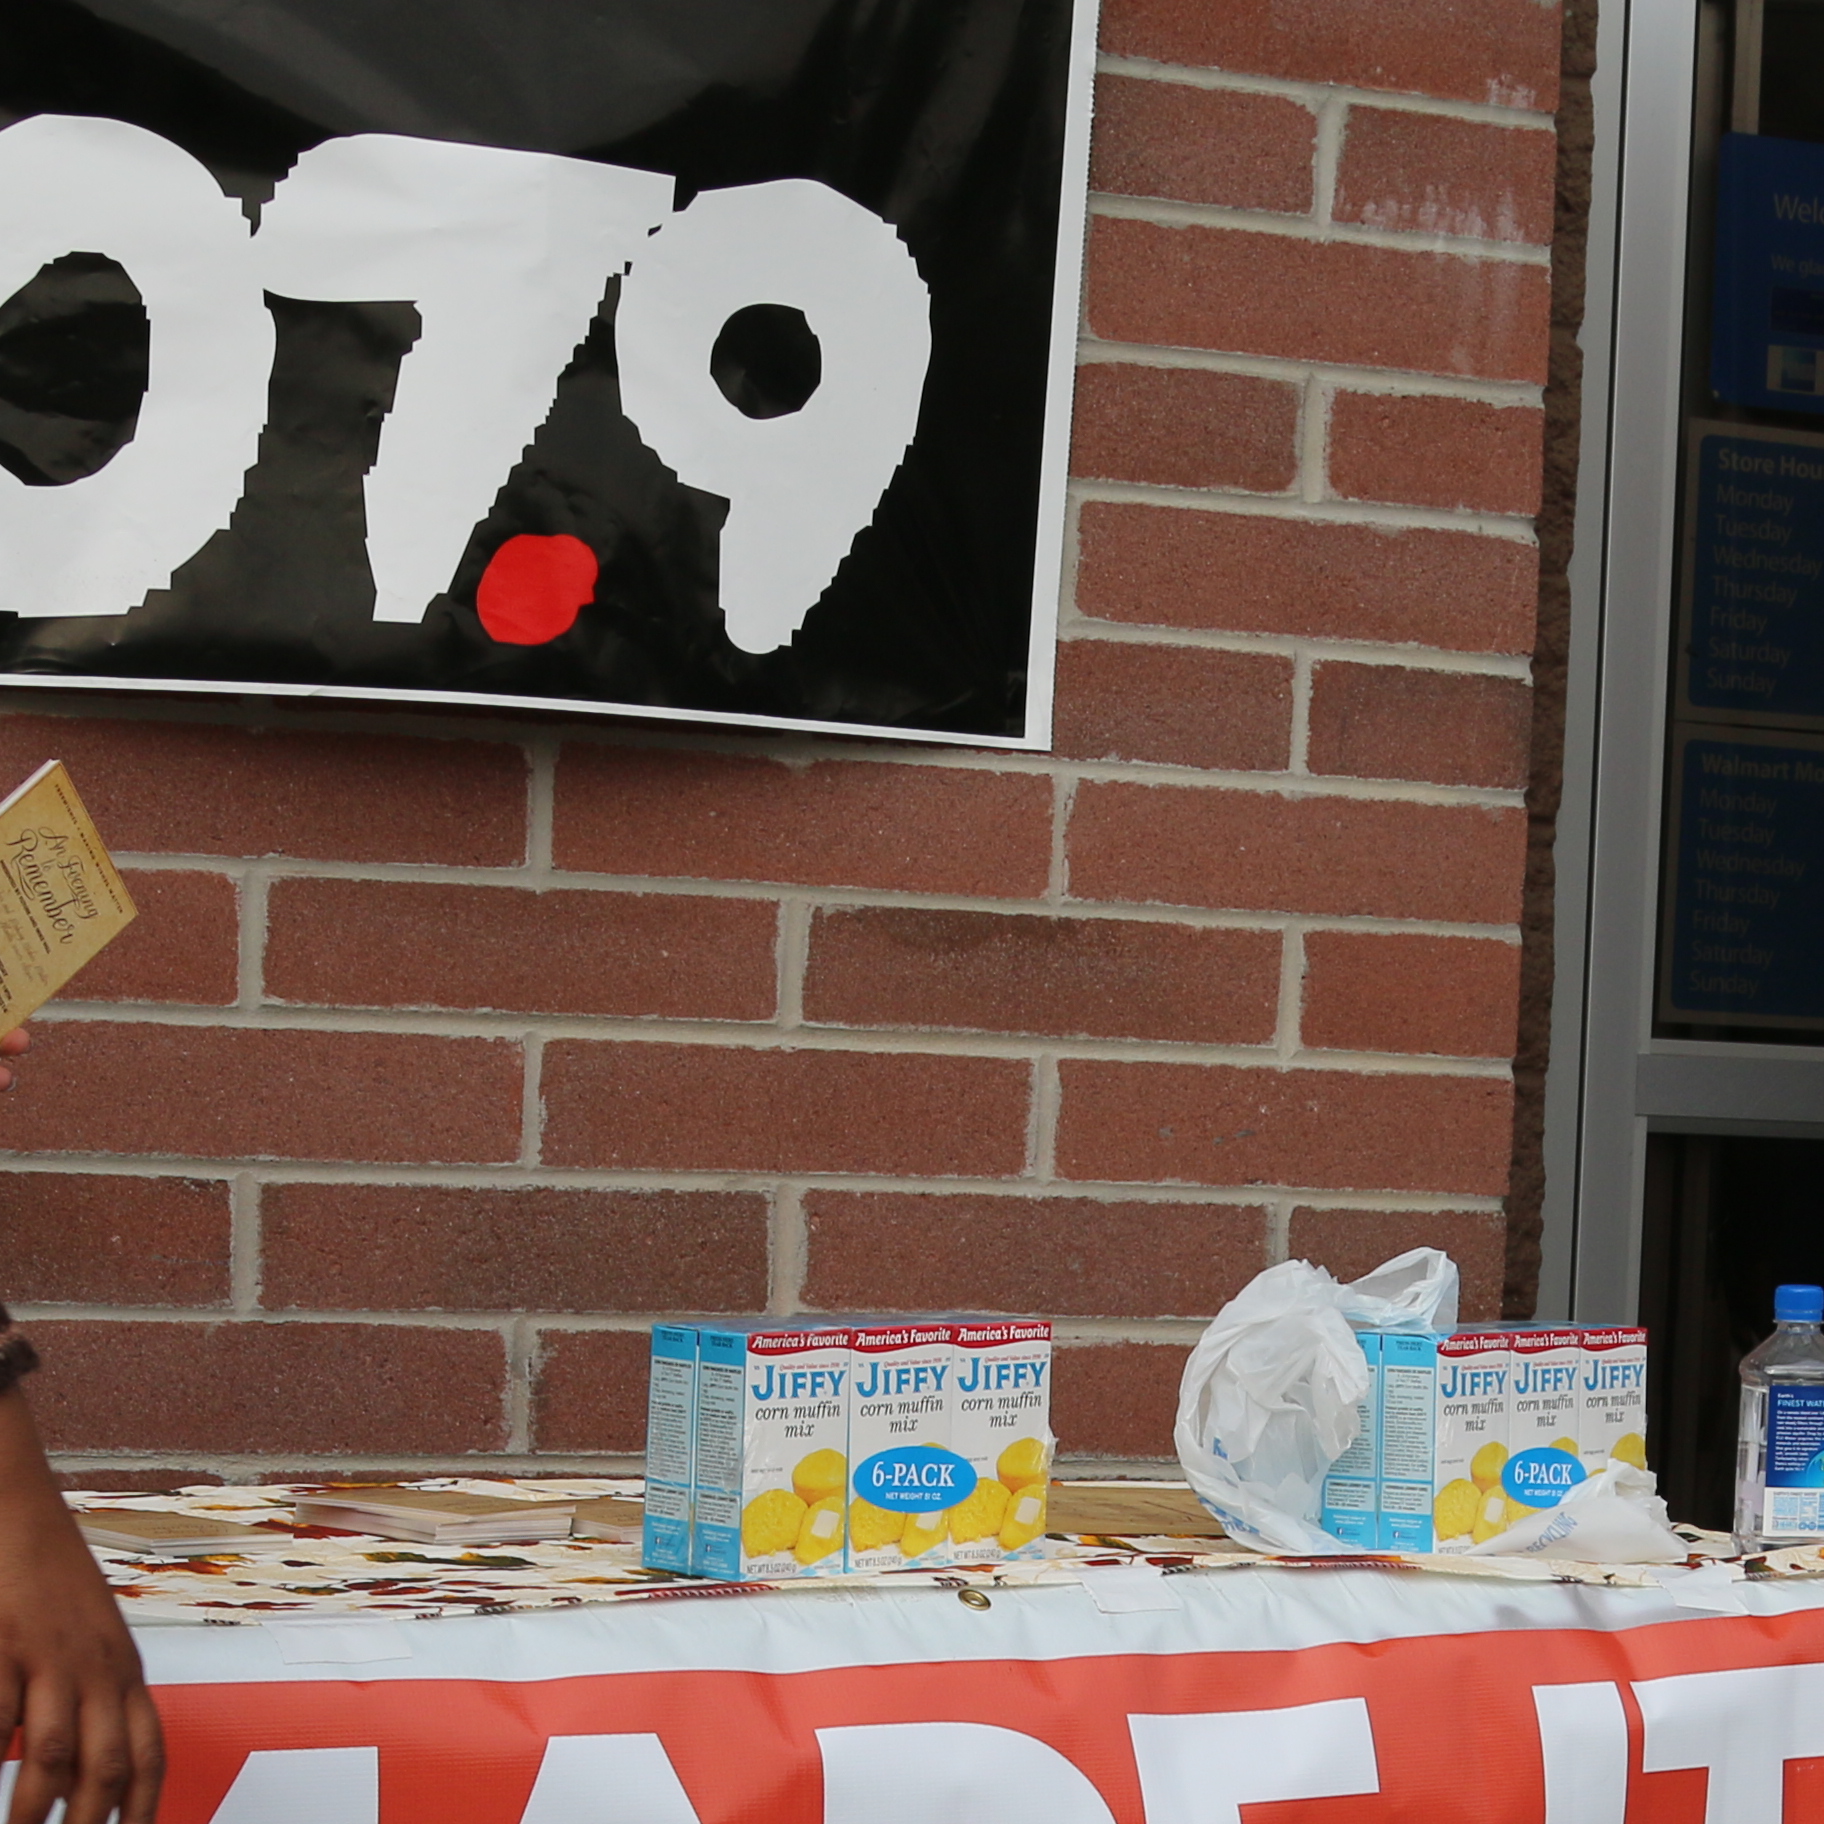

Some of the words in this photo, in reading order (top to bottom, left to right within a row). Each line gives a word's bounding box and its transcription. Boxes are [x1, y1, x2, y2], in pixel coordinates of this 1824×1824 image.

[1717, 448, 1774, 475] Store
[1716, 483, 1794, 516] Monday
[1715, 515, 1792, 547] Tuesday
[1713, 545, 1822, 581] Wednesday
[1712, 575, 1798, 608] Thursday
[1709, 606, 1768, 637] Friday
[1708, 637, 1791, 667] Saturday
[1707, 667, 1777, 699] Sunday
[1702, 752, 1789, 780] Walmart
[1699, 788, 1776, 818] Monday
[1698, 819, 1775, 848] Tuesday
[1696, 849, 1805, 882] Wednesday
[3, 826, 89, 949] Remember
[1695, 878, 1780, 909] Thursday
[1692, 910, 1750, 938] Friday
[1691, 941, 1773, 971] Saturday
[1689, 970, 1759, 998] Sunday
[752, 1333, 805, 1349] America's
[807, 1333, 849, 1347] Favorite
[856, 1331, 909, 1346] America's
[910, 1327, 951, 1343] Favorite
[957, 1326, 1007, 1341] America's
[1009, 1324, 1049, 1339] Favorite
[1441, 1338, 1478, 1351] America's
[1480, 1335, 1510, 1349] Favorite
[1514, 1335, 1549, 1348] America's
[1550, 1333, 1579, 1346] Favorite
[1583, 1332, 1617, 1345] America's
[1618, 1331, 1646, 1343] Favorite
[751, 1364, 848, 1400] JIFFY
[855, 1362, 949, 1398] JIFFY
[957, 1357, 1048, 1392] JIFFY
[1440, 1365, 1507, 1398] JIFFY
[1514, 1362, 1578, 1394] JIFFY
[1583, 1359, 1644, 1391] JIFFY
[756, 1407, 789, 1421] corn
[794, 1402, 841, 1418] muffin
[860, 1404, 893, 1417] corn
[898, 1396, 944, 1415] muffin
[961, 1398, 993, 1411] corn
[997, 1391, 1042, 1410] muffin
[1444, 1403, 1468, 1416] corn
[1471, 1398, 1504, 1414] muffin
[1517, 1400, 1540, 1412] corn
[1542, 1394, 1574, 1410] muffin
[1586, 1396, 1608, 1408] corn
[1611, 1391, 1641, 1406] muffin
[1777, 1399, 1805, 1407] FINEST
[785, 1421, 815, 1438] mix
[889, 1416, 918, 1433] mix
[989, 1411, 1018, 1428] mix
[1465, 1416, 1486, 1431] mix
[1536, 1412, 1557, 1428] mix
[1605, 1408, 1625, 1424] mix
[872, 1461, 955, 1487] 6-PACK
[1515, 1461, 1572, 1485] 6-PACK
